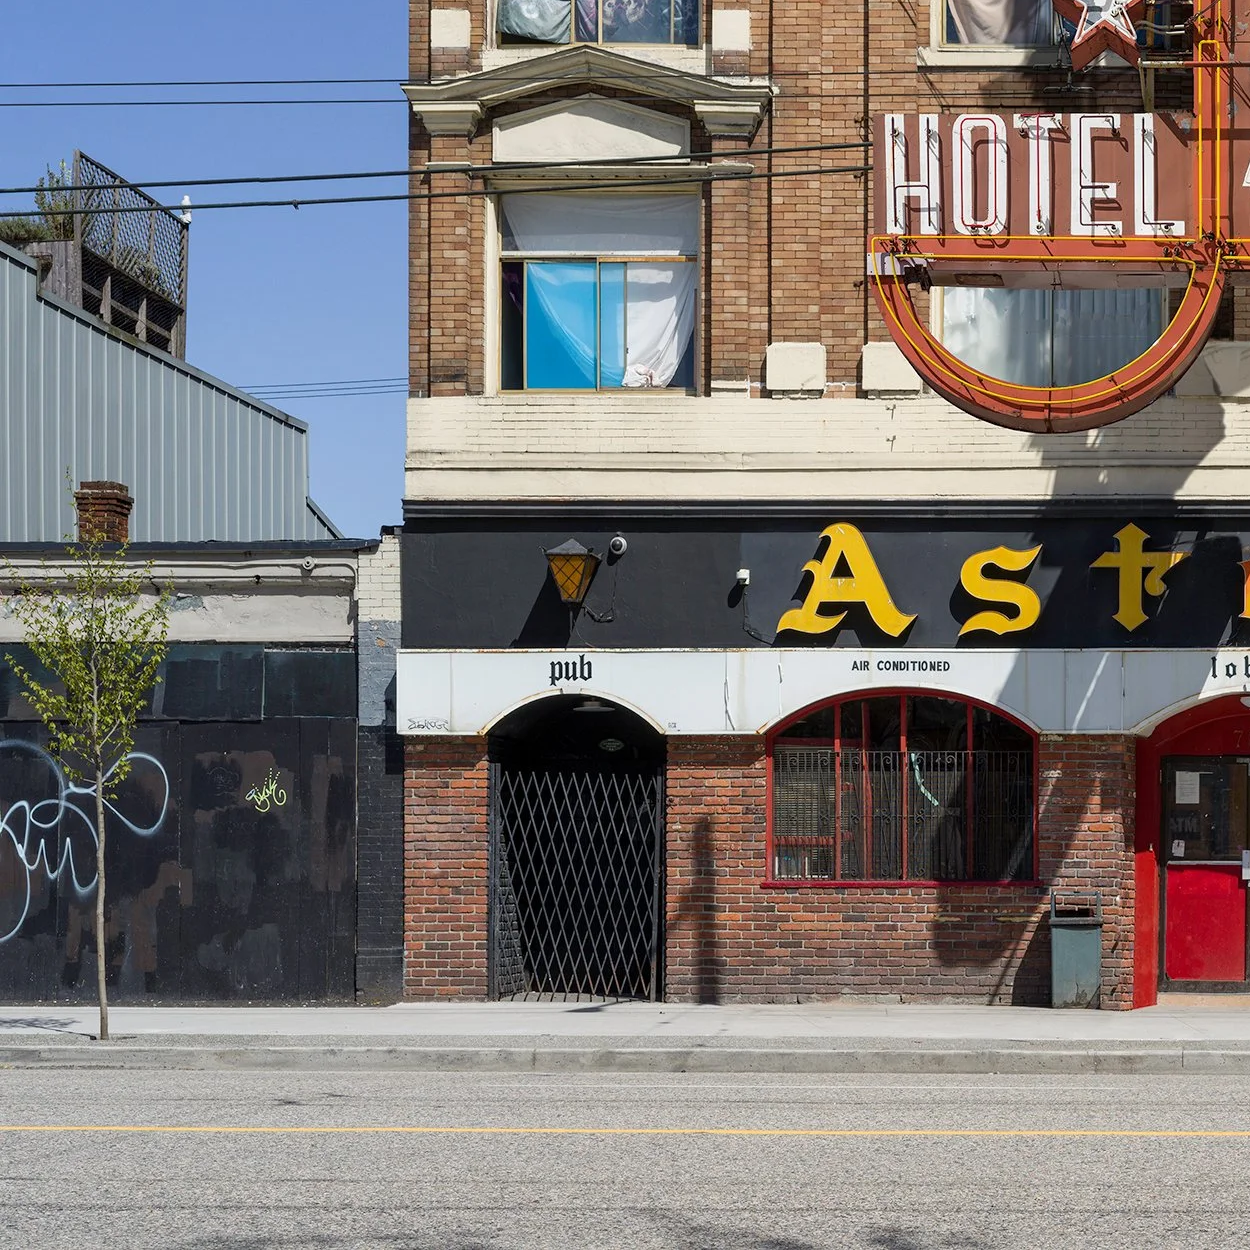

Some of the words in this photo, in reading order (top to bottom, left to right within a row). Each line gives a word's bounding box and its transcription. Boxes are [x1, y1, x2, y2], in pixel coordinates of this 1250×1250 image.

[884, 112, 1186, 236] HOTEL
[549, 653, 593, 687] pub
[851, 660, 870, 672] AIR
[876, 660, 951, 672] CONDITIONED
